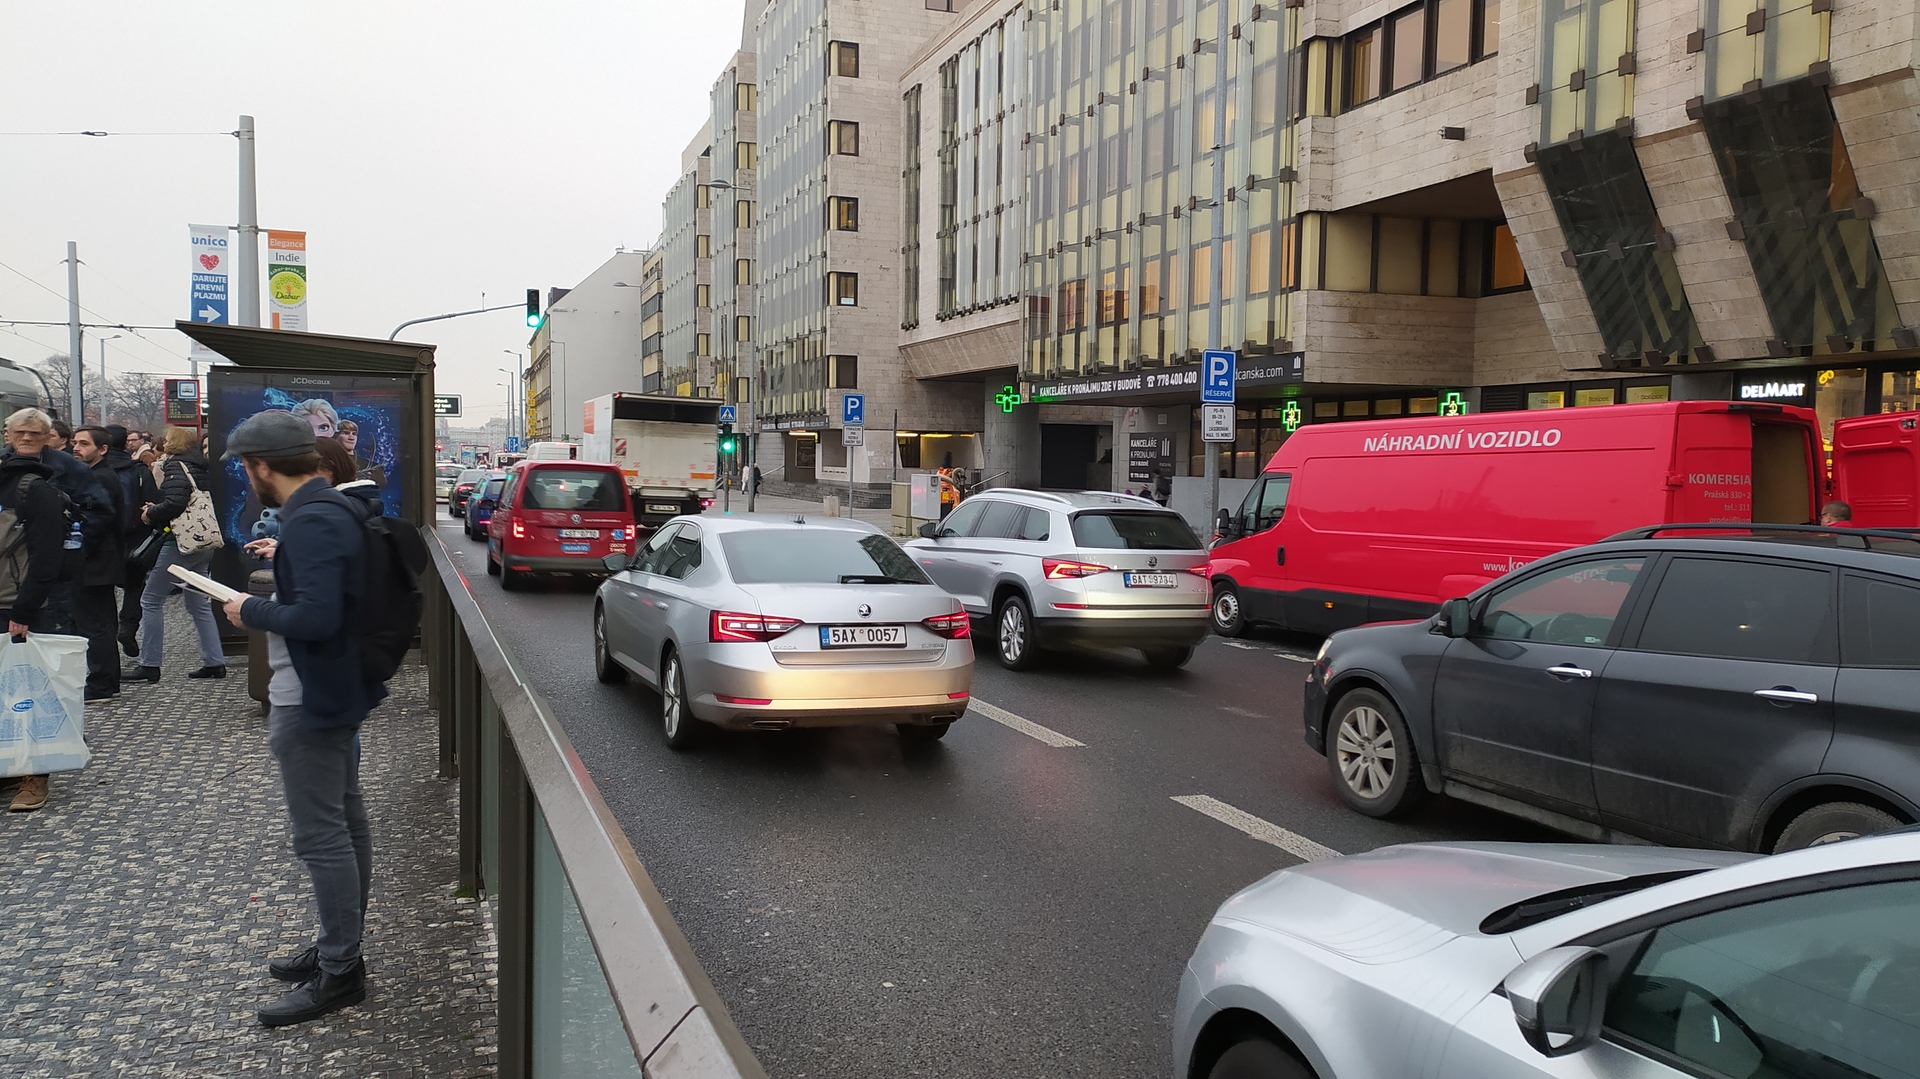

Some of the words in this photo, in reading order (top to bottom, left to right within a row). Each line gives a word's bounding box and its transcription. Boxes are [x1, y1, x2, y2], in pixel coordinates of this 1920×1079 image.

[192, 235, 227, 246] unica
[270, 238, 304, 248] Elegance
[275, 252, 300, 262] Indie
[192, 274, 227, 284] DARUJTE
[195, 283, 224, 292] KREVNÍ
[194, 292, 226, 300] PLAZMU
[274, 291, 300, 300] Dabur
[1210, 356, 1228, 386] P
[1040, 382, 1066, 397] KANCELÁŘE
[1068, 384, 1072, 394] K
[1072, 380, 1100, 394] PRONÁJMU
[1101, 381, 1112, 392] ZDE
[1113, 380, 1117, 391] V
[1118, 375, 1141, 390] BUDOVĚ
[1157, 374, 1170, 387] 778
[1170, 373, 1183, 385] 400
[1184, 371, 1197, 384] 400
[1742, 382, 1806, 398] DELMART
[848, 398, 860, 414] P
[1130, 437, 1157, 447] KANCELÁŘE
[1364, 429, 1464, 452] NÁHRADNÍ
[1467, 429, 1561, 448] VOZIDLO
[1689, 474, 1751, 485] KOMERSIA
[832, 629, 856, 643] 5AX
[867, 628, 898, 642] 0057
